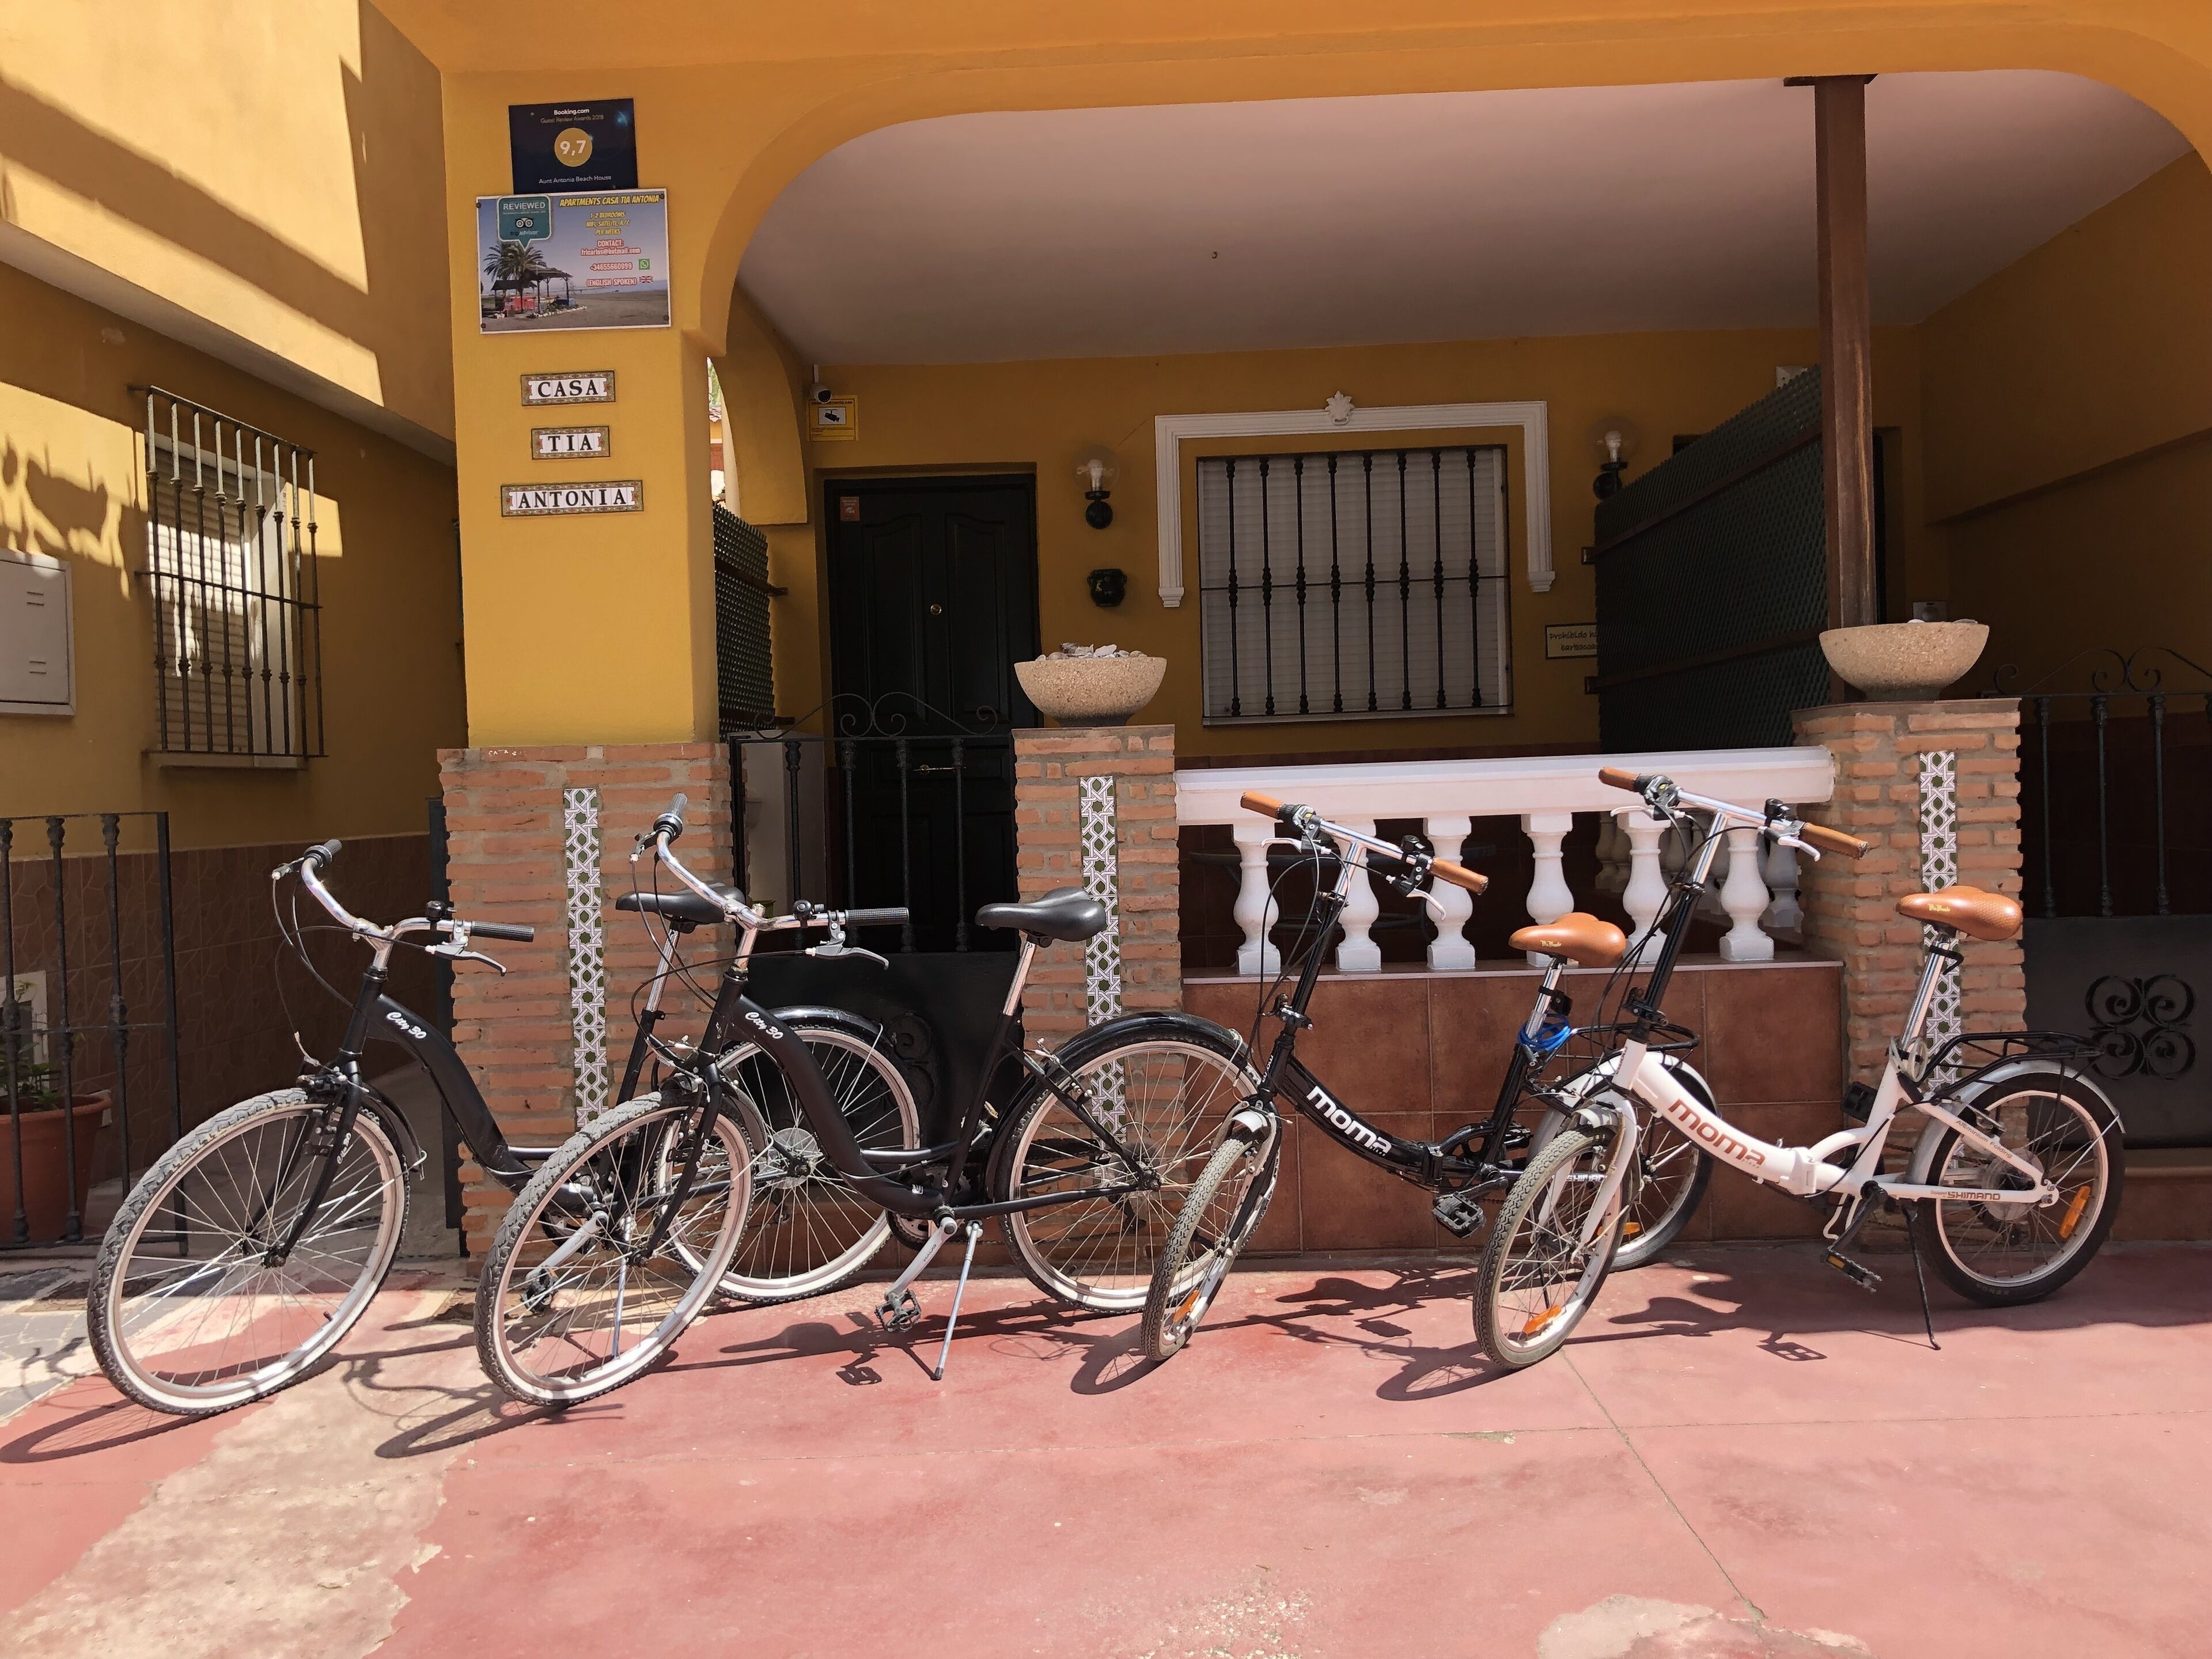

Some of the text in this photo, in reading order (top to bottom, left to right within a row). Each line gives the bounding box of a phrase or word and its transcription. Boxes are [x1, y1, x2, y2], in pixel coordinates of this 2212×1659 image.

[559, 140, 586, 156] 9,7
[503, 202, 546, 210] REVIEWED
[559, 195, 660, 207] APARTMENTS CASA TIA ANTONIA
[597, 239, 624, 248] CONTACT:
[587, 277, 637, 287] (ENGLISH SPOKEN)
[537, 379, 599, 397] CASA
[548, 434, 593, 452] TIA
[518, 488, 626, 509] ANTONIA
[386, 1012, 427, 1039] City 30
[745, 1012, 783, 1039] City 30
[1306, 1085, 1392, 1154] moma
[1668, 1099, 1766, 1165] moma
[1990, 1142, 2013, 1159] Folding
[1947, 1191, 2001, 1200] SHIMANO
